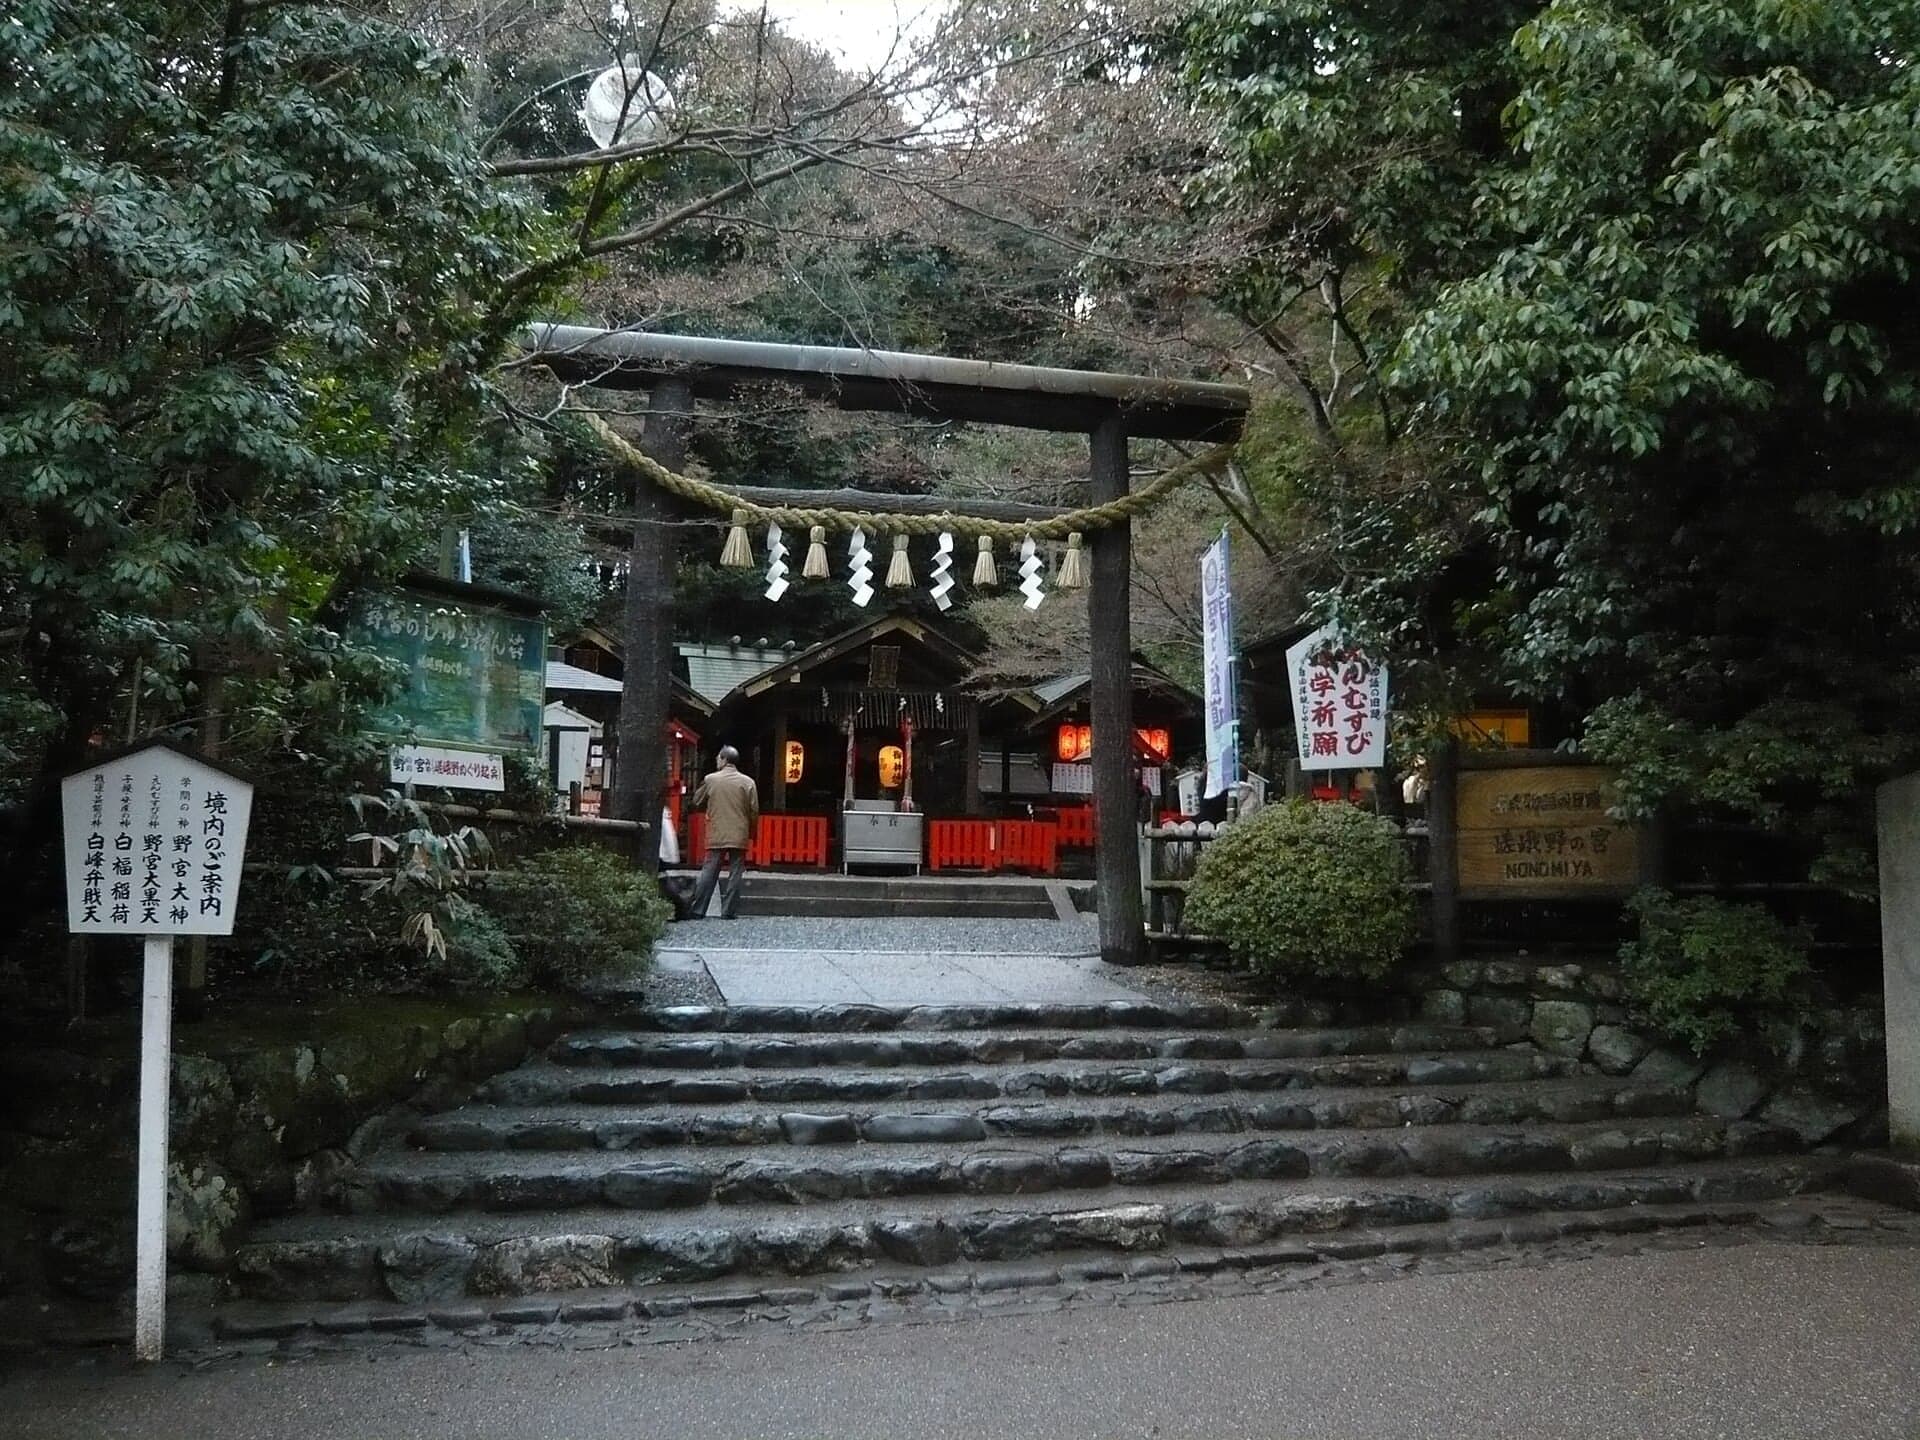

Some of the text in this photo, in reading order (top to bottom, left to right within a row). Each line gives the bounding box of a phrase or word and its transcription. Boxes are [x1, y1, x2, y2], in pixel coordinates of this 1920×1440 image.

[1309, 648, 1338, 757] 学祈願
[110, 831, 134, 924] 白福稲荷
[140, 833, 164, 924] 野宮大黒天
[169, 777, 192, 925] 学問の神 野宮大神
[200, 790, 228, 917] 境内のご案内
[1506, 859, 1593, 879] NONOMIYA
